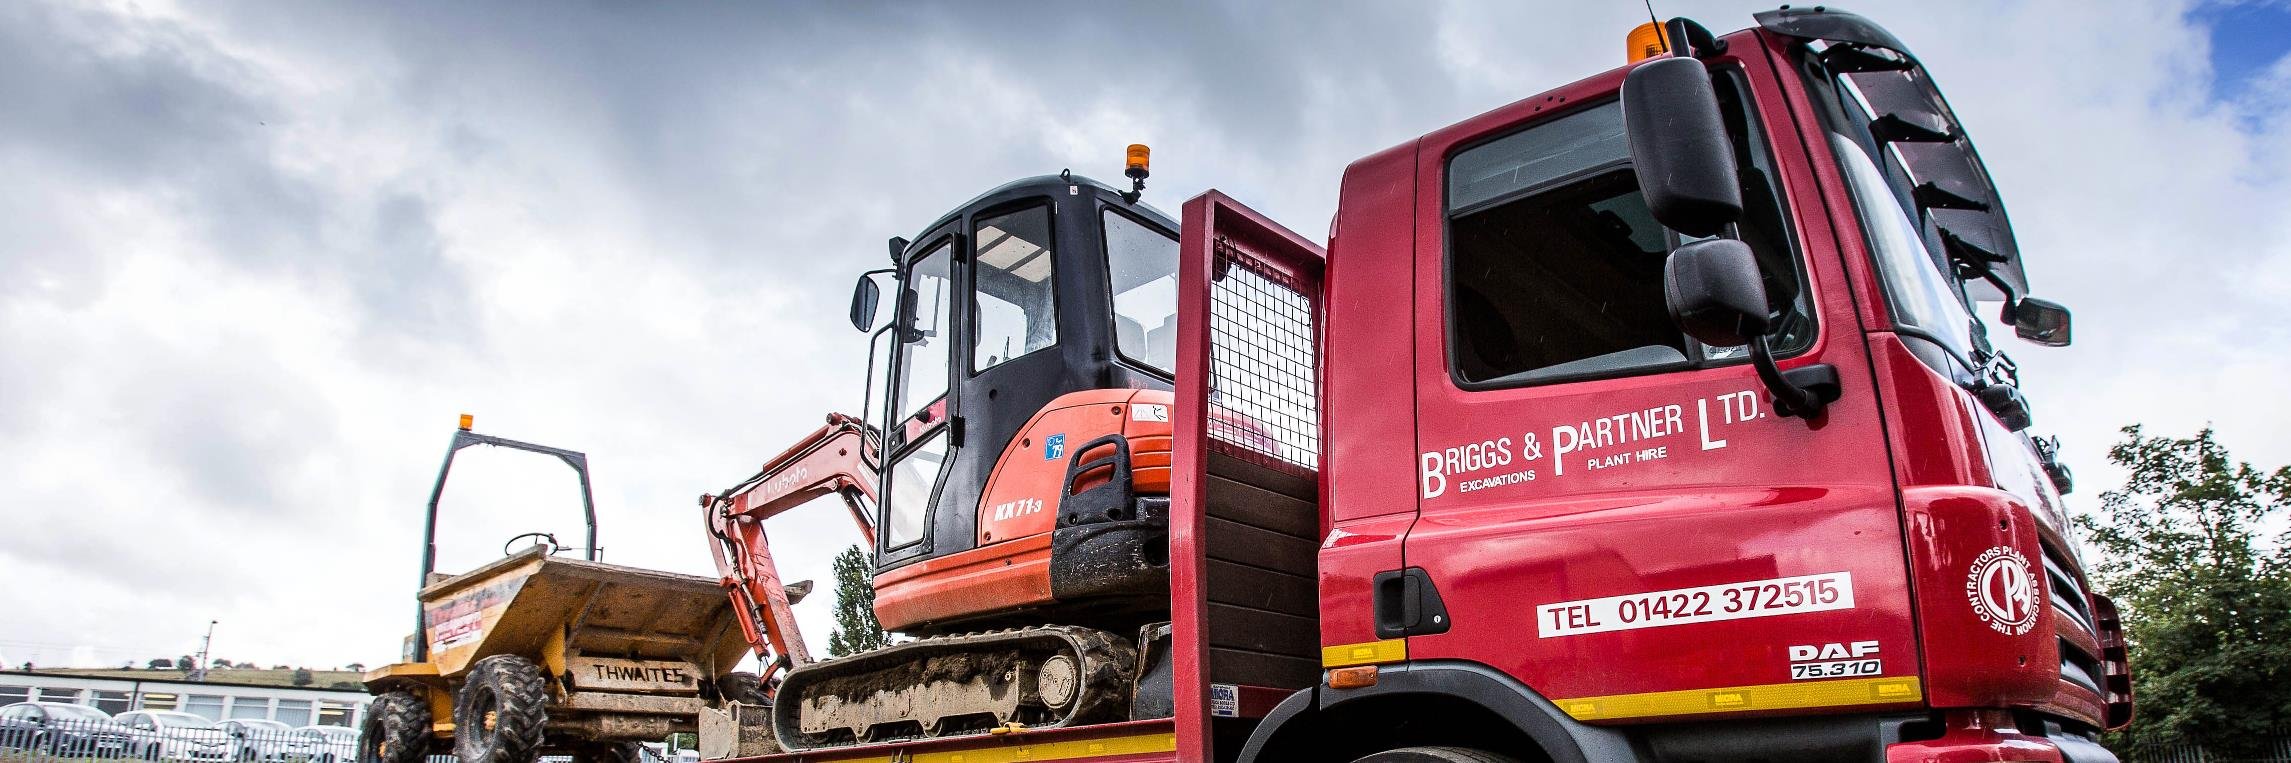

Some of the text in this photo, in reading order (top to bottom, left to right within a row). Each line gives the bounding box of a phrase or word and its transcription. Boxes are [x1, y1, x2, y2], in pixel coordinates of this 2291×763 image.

[1421, 390, 1765, 499] BRIGGS & PARTNER LTD.
[1587, 446, 1668, 471] PLANT HIRE
[1459, 469, 1536, 493] EXCAVATIONS
[1966, 545, 2040, 636] THE CONTRACTORS PLANT ASSOCIATION
[1981, 559, 2032, 621] CPA
[1547, 578, 1839, 630] TEL 01422 372515
[1788, 640, 1880, 661] DAF
[592, 664, 686, 683] THWAITES
[1792, 660, 1880, 678] 75.310
